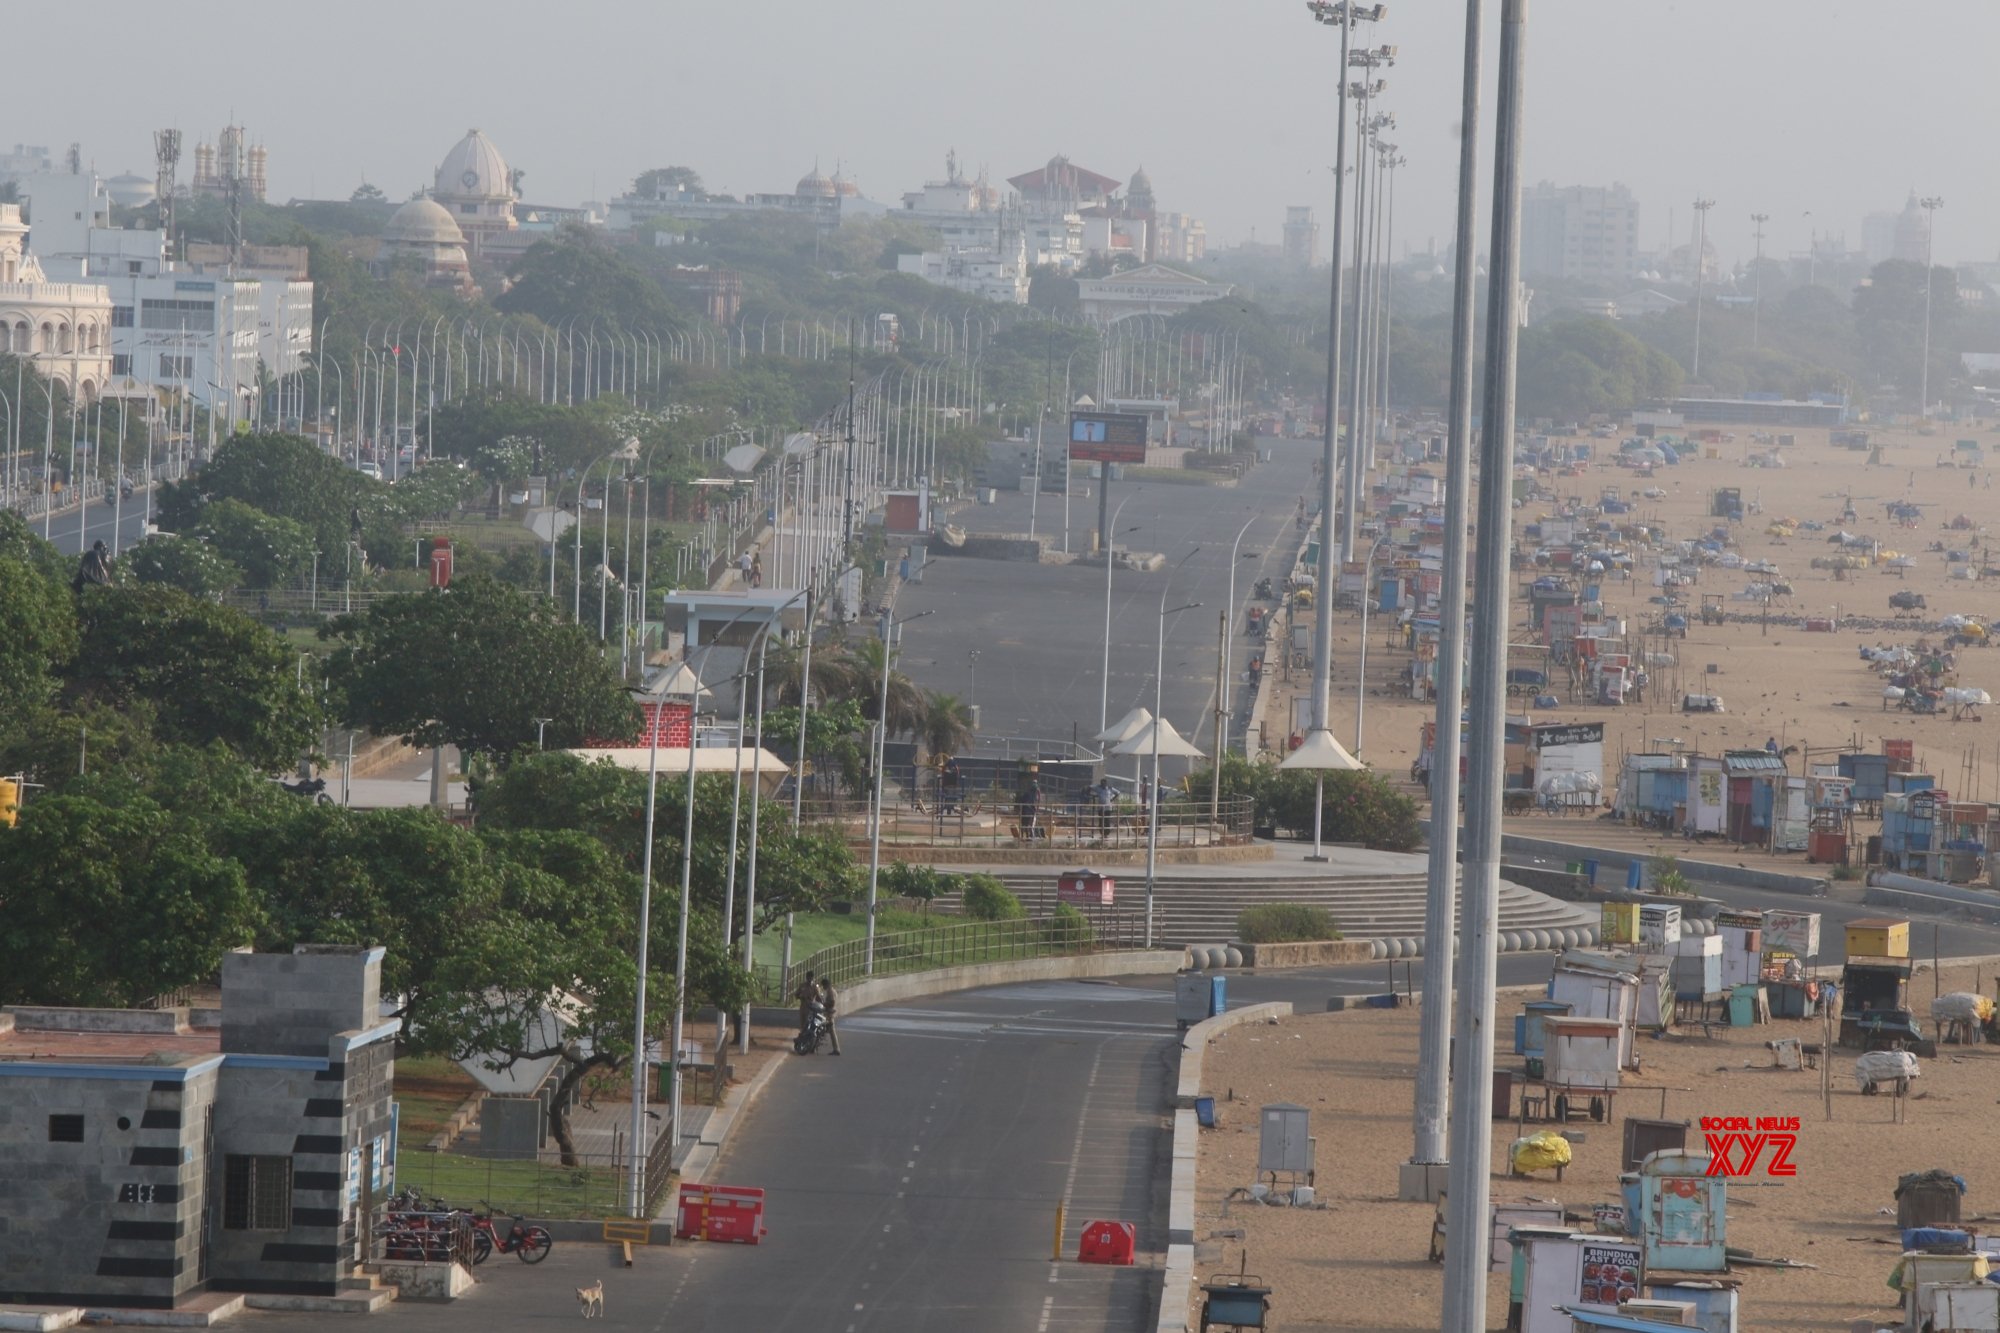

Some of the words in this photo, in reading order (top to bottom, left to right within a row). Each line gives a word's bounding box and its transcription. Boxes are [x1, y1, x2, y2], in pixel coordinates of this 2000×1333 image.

[1589, 1249, 1634, 1259] BRINDHA
[1584, 1255, 1609, 1263] FAST
[1612, 1257, 1639, 1266] FOOD
